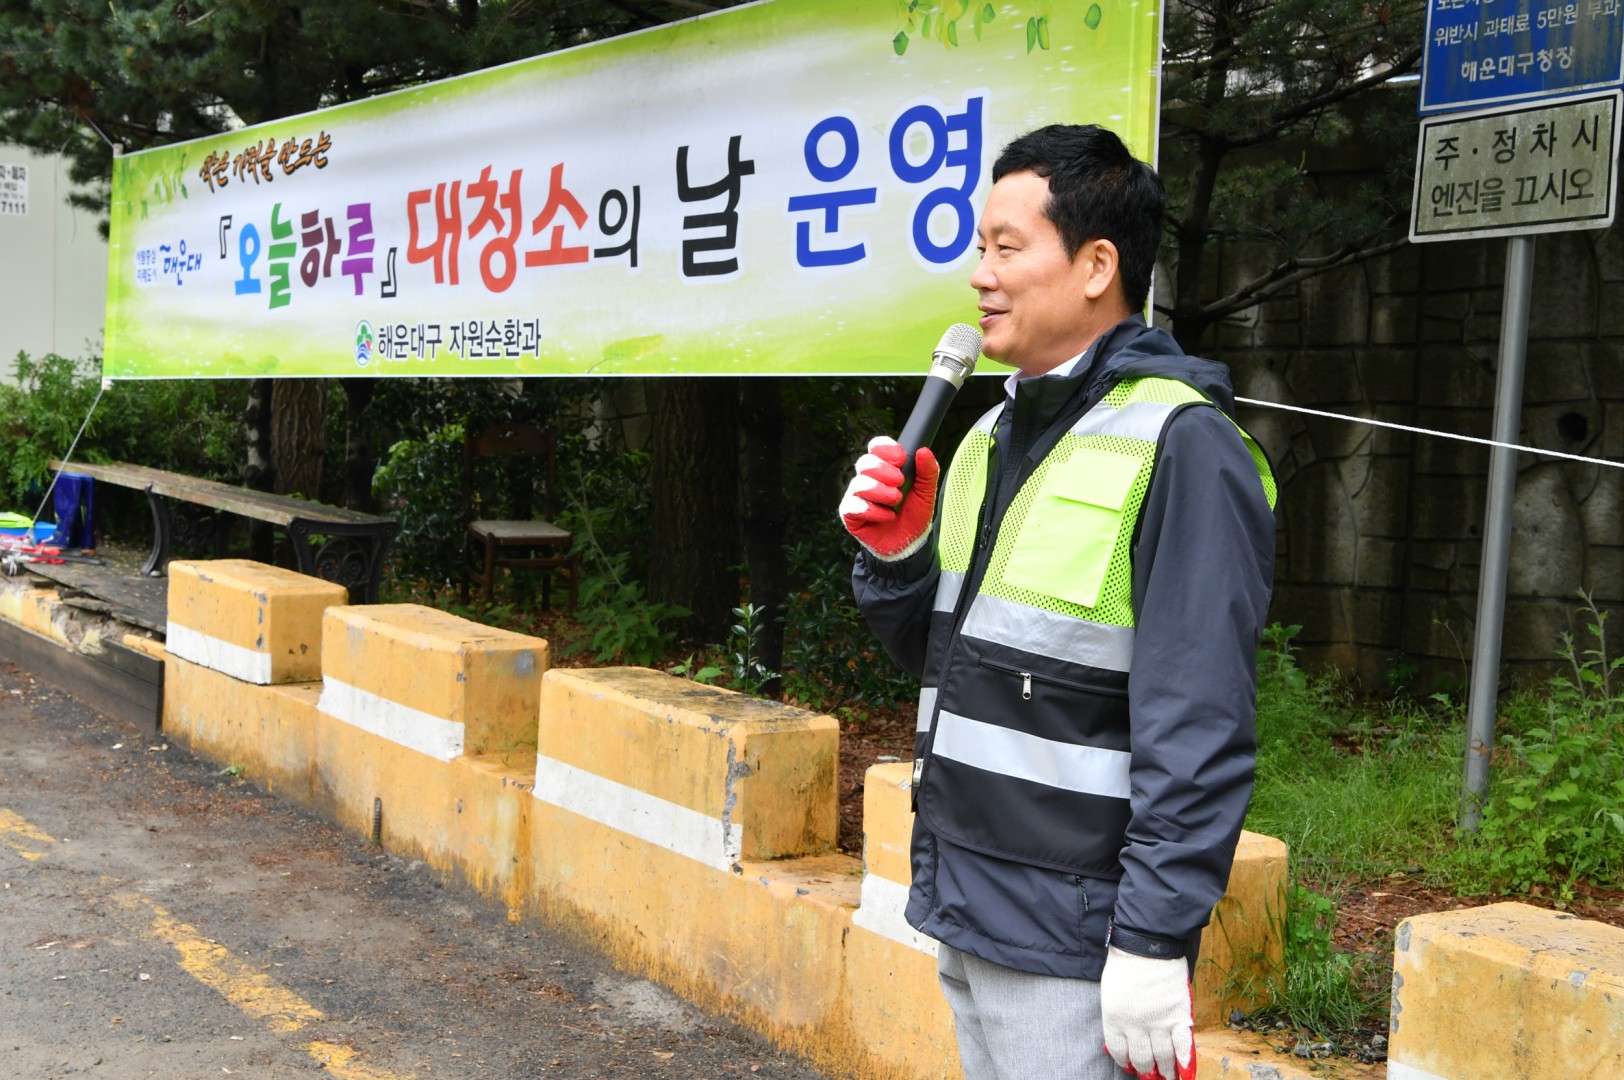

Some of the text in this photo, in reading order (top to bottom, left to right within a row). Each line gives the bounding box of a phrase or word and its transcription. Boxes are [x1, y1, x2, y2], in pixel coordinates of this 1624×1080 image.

[1434, 0, 1620, 46] 위반시 과태료 5만원 부과
[1461, 47, 1574, 83] 해운대구청장
[676, 135, 755, 277] 날
[788, 96, 984, 268] 운영
[1431, 168, 1594, 217] 엔진을 끄시오
[378, 318, 541, 359] 해운대구 자원순환과
